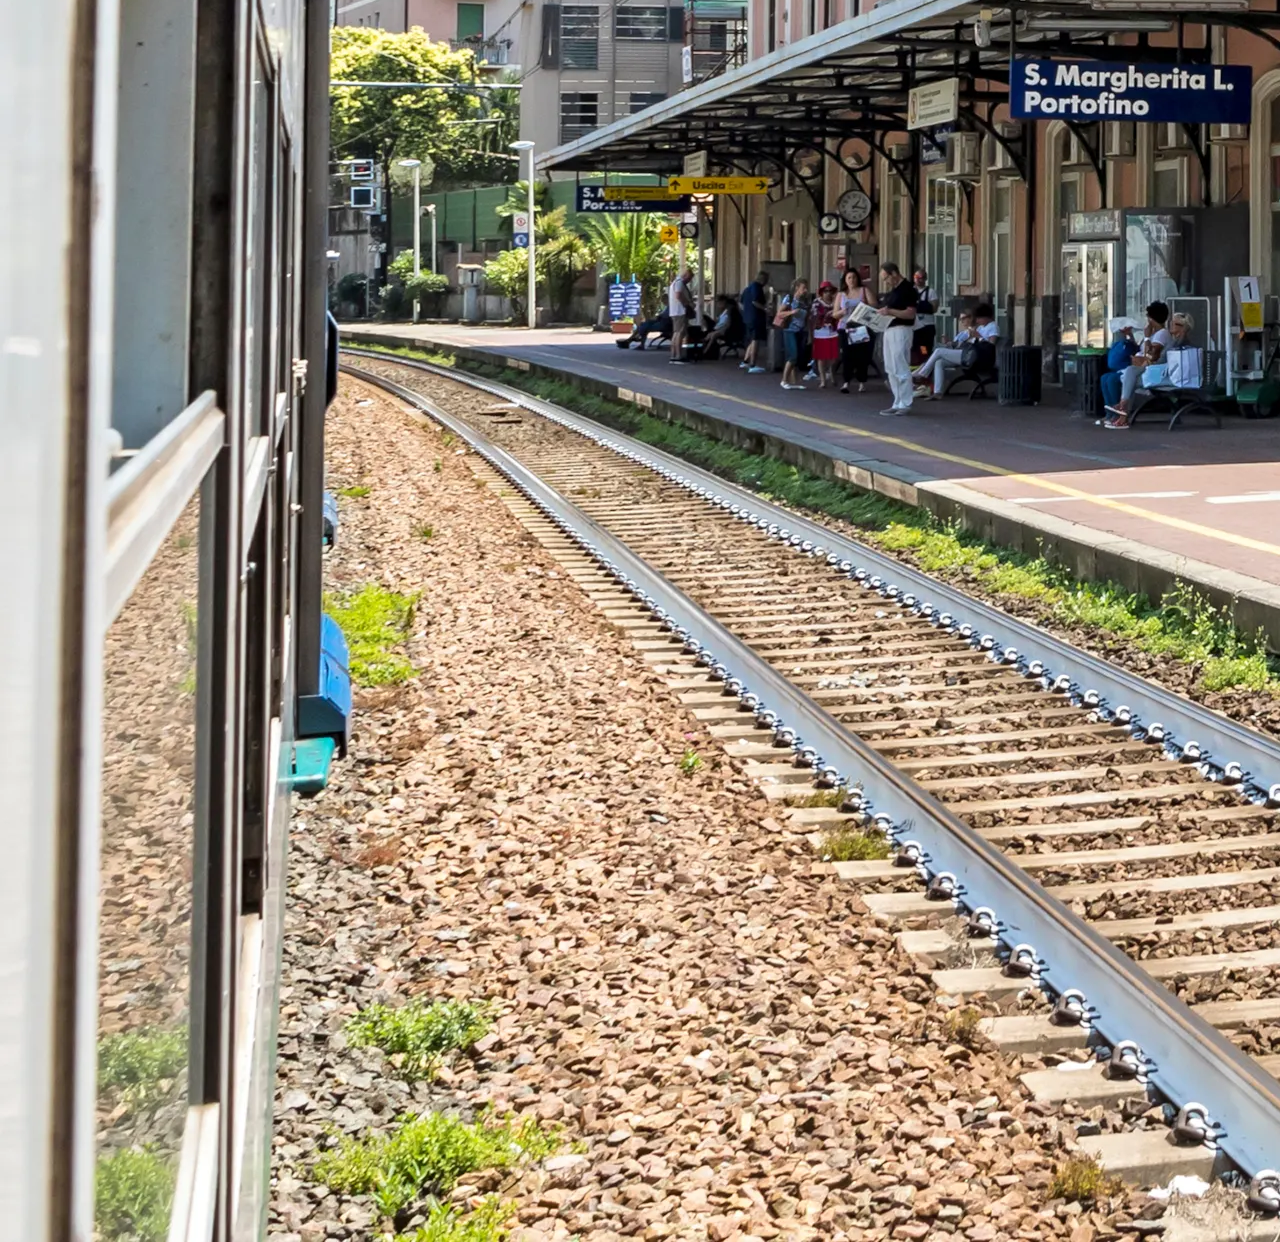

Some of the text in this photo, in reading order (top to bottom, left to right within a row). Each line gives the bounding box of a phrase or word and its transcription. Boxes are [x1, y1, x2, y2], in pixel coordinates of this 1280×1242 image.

[1024, 63, 1235, 93] S. Margherita L.
[1023, 91, 1150, 116] Portofino
[692, 180, 726, 190] Uscita
[1243, 281, 1253, 300] 1
